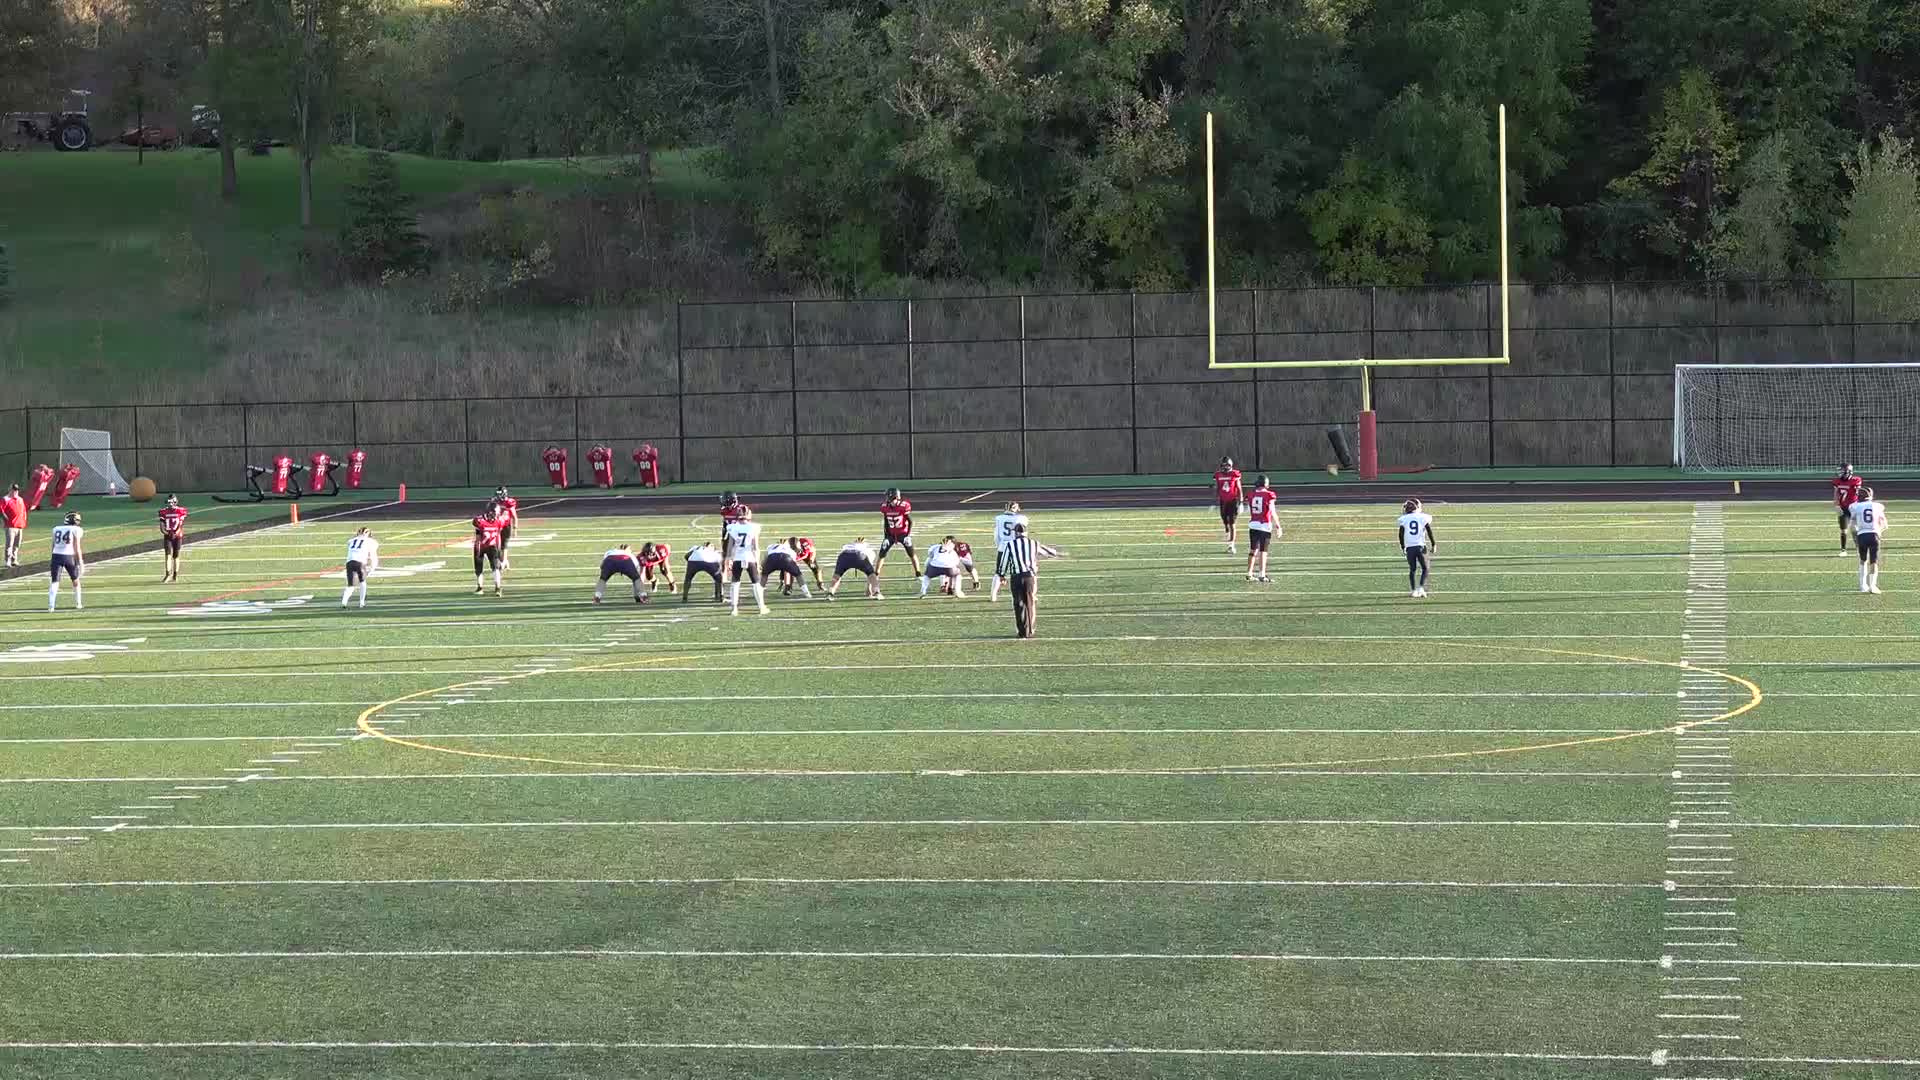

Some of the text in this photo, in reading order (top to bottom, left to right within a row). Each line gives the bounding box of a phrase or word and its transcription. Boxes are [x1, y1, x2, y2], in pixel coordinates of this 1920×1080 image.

[1222, 481, 1230, 493] 4
[1840, 488, 1848, 502] 7
[1251, 496, 1263, 514] 9
[886, 515, 904, 529] 52
[1863, 508, 1873, 524] 6
[165, 517, 180, 531] 17
[1409, 520, 1419, 536] 9
[54, 530, 71, 545] 84
[350, 538, 364, 549] 11
[738, 532, 748, 548] 7
